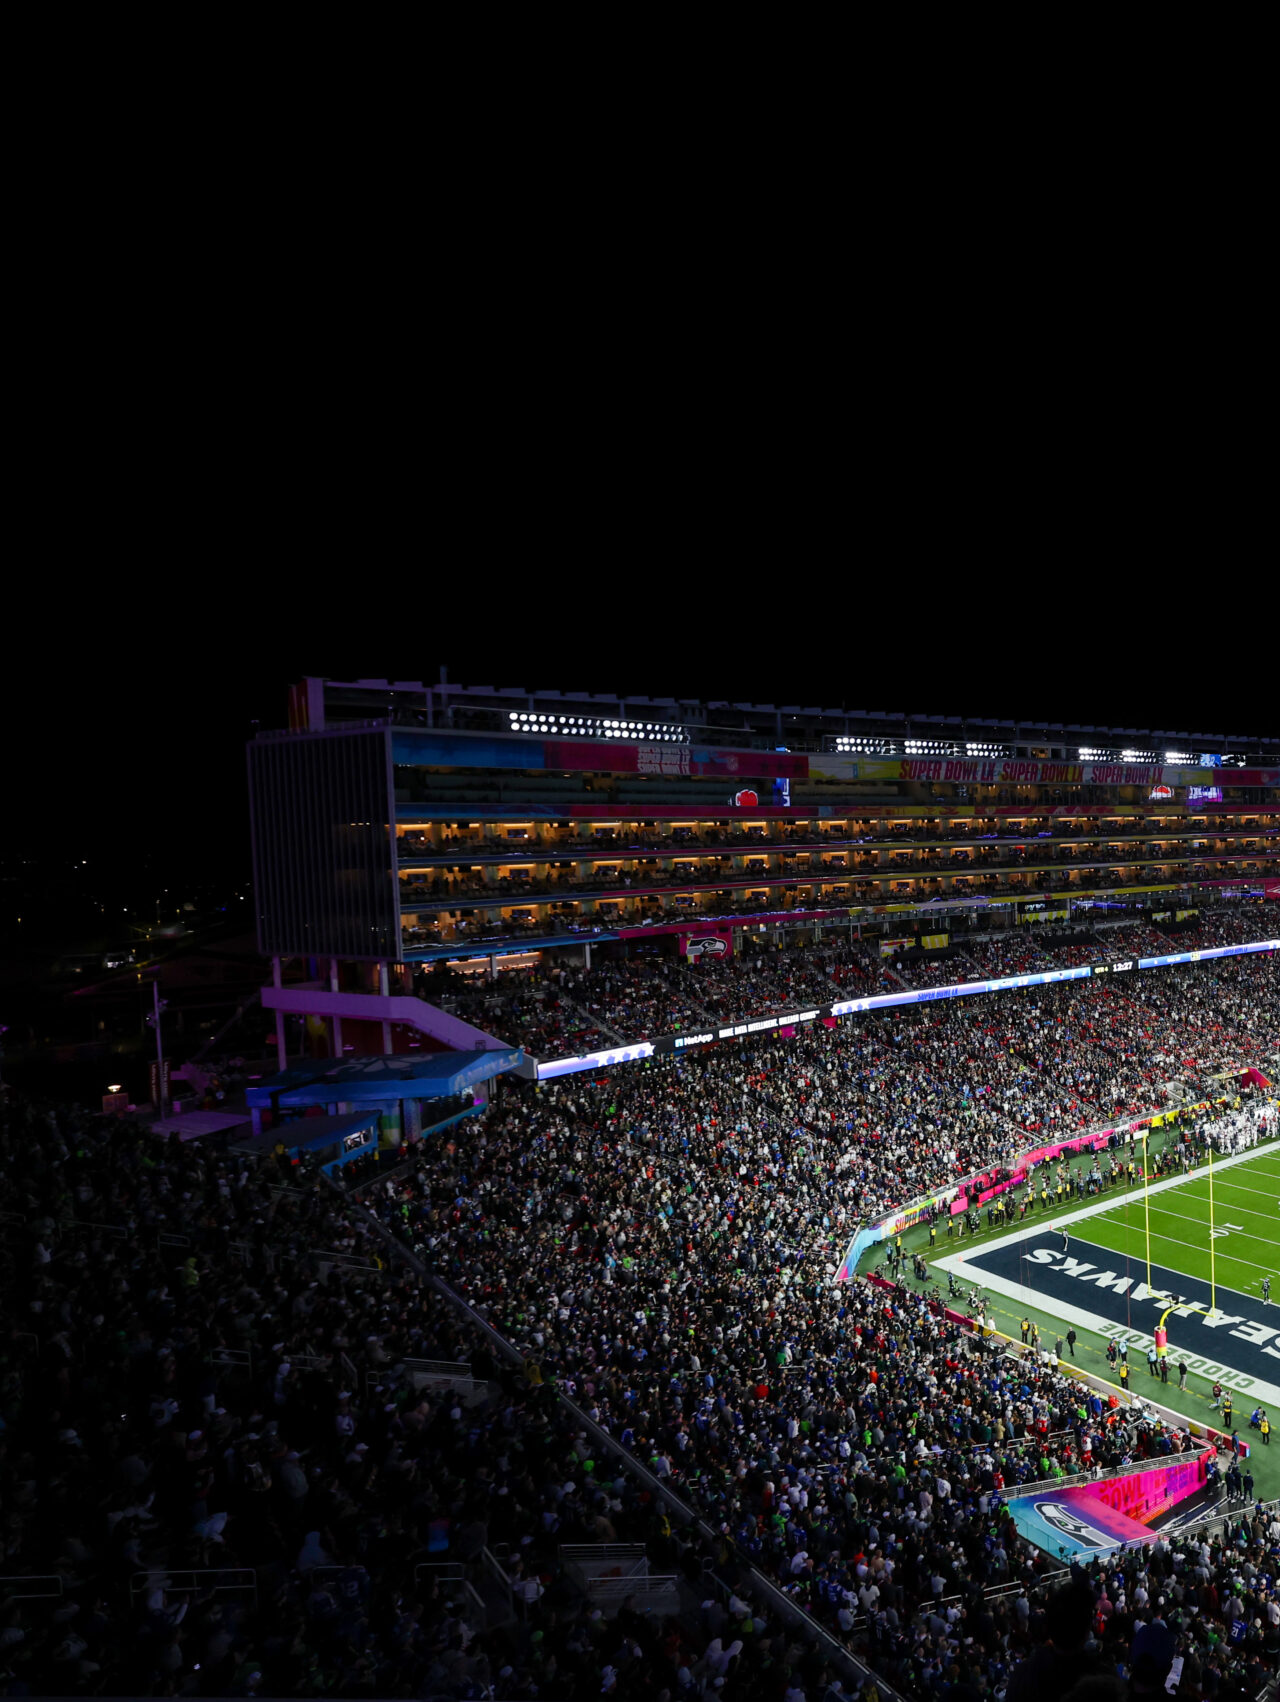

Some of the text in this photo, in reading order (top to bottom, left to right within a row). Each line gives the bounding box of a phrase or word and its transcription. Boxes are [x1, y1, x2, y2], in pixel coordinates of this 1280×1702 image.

[900, 760, 996, 781] SUPER BOWL LX
[1001, 762, 1039, 781] SUPER
[1040, 763, 1068, 782] BOWL
[1091, 765, 1122, 783] SUPER
[1125, 766, 1150, 784] BOWL
[1113, 961, 1133, 972] 12:27
[684, 1032, 713, 1046] NetApp
[1209, 1223, 1244, 1239] 10
[1098, 1323, 1156, 1349] LOVE
